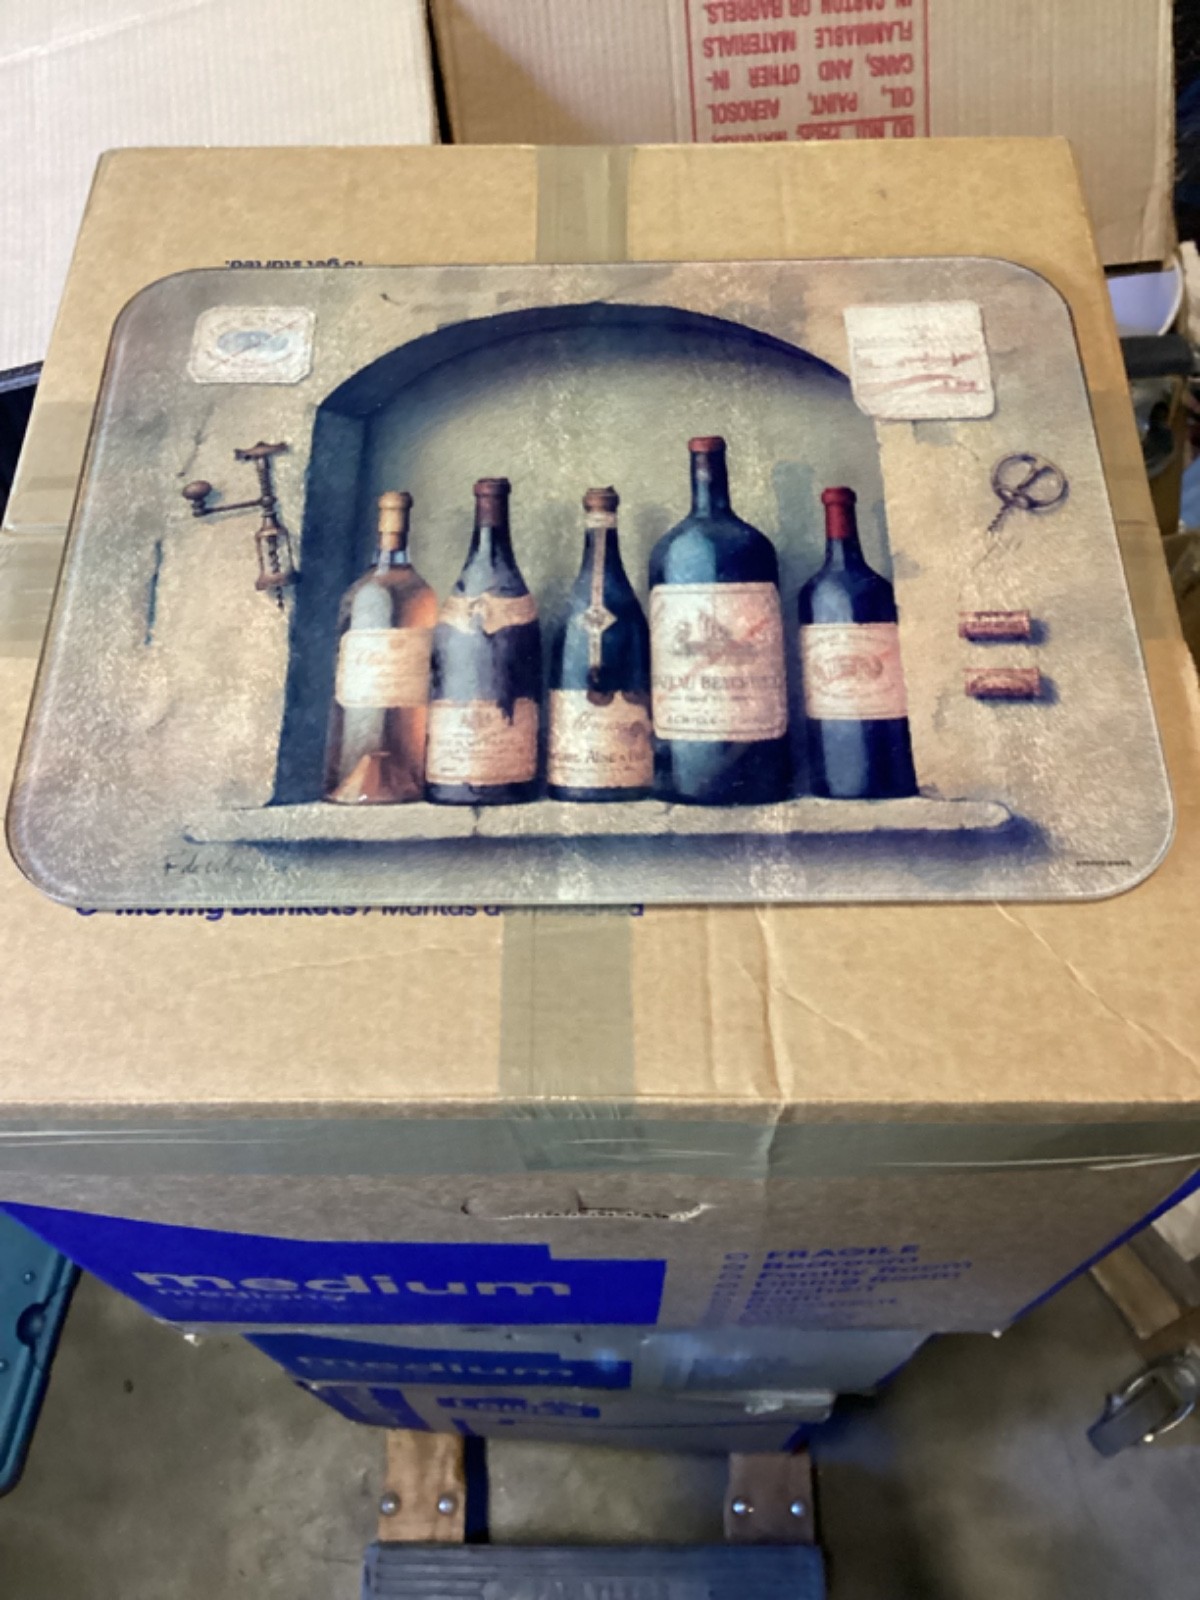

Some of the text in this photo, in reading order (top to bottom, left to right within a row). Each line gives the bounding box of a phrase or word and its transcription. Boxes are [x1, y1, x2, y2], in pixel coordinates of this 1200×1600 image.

[702, 21, 913, 58] FLAMMABLE MATERIALS
[705, 53, 914, 90] CANS, AND OTHER IN-
[707, 86, 914, 124] OIL, PAINT, AEROSOL
[131, 1270, 571, 1296] medium
